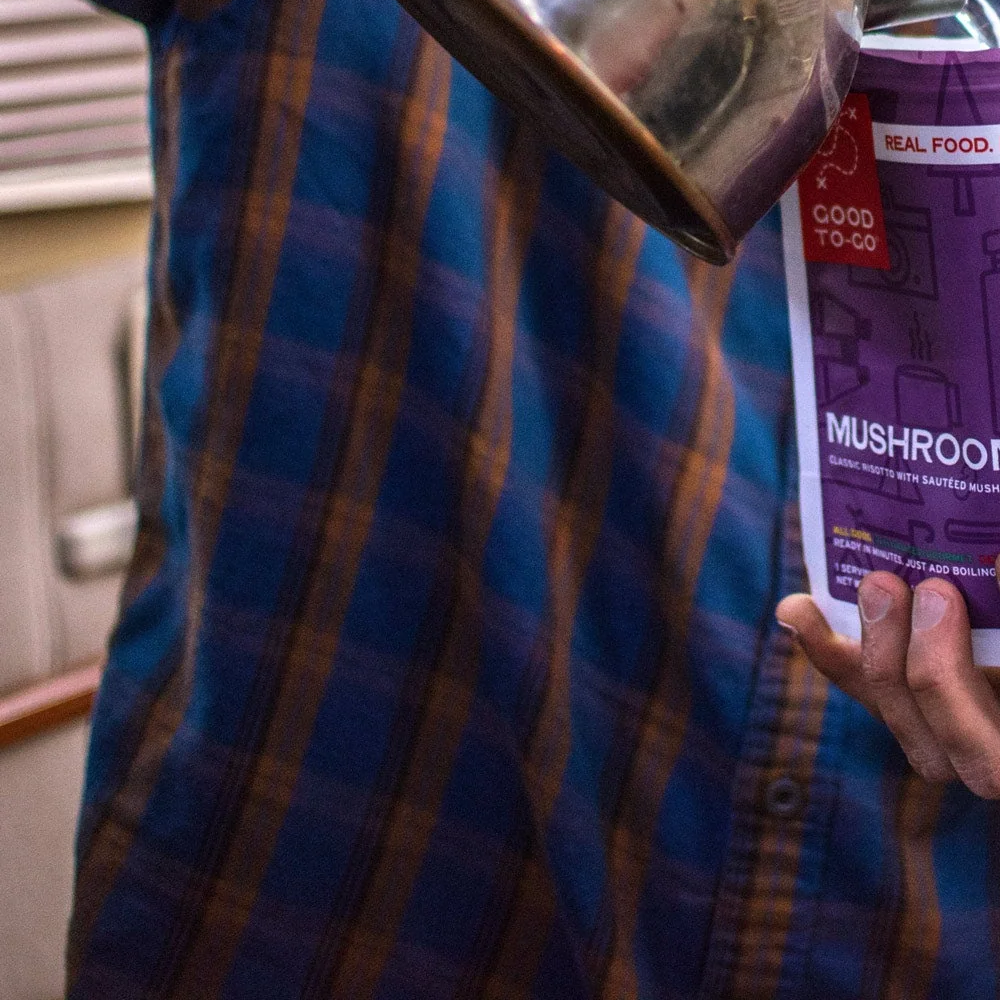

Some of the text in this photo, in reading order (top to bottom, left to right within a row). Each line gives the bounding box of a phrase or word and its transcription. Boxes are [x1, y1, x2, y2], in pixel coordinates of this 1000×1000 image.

[885, 134, 927, 153] REAL
[932, 137, 994, 153] FOOD.
[812, 203, 875, 229] GOOD
[814, 228, 877, 252] TO-GO
[862, 462, 895, 479] RISOTTO
[896, 471, 919, 484] WITH
[832, 537, 861, 551] READY
[905, 559, 927, 571] JUST
[928, 563, 951, 575] ADD
[952, 566, 997, 577] BOILING
